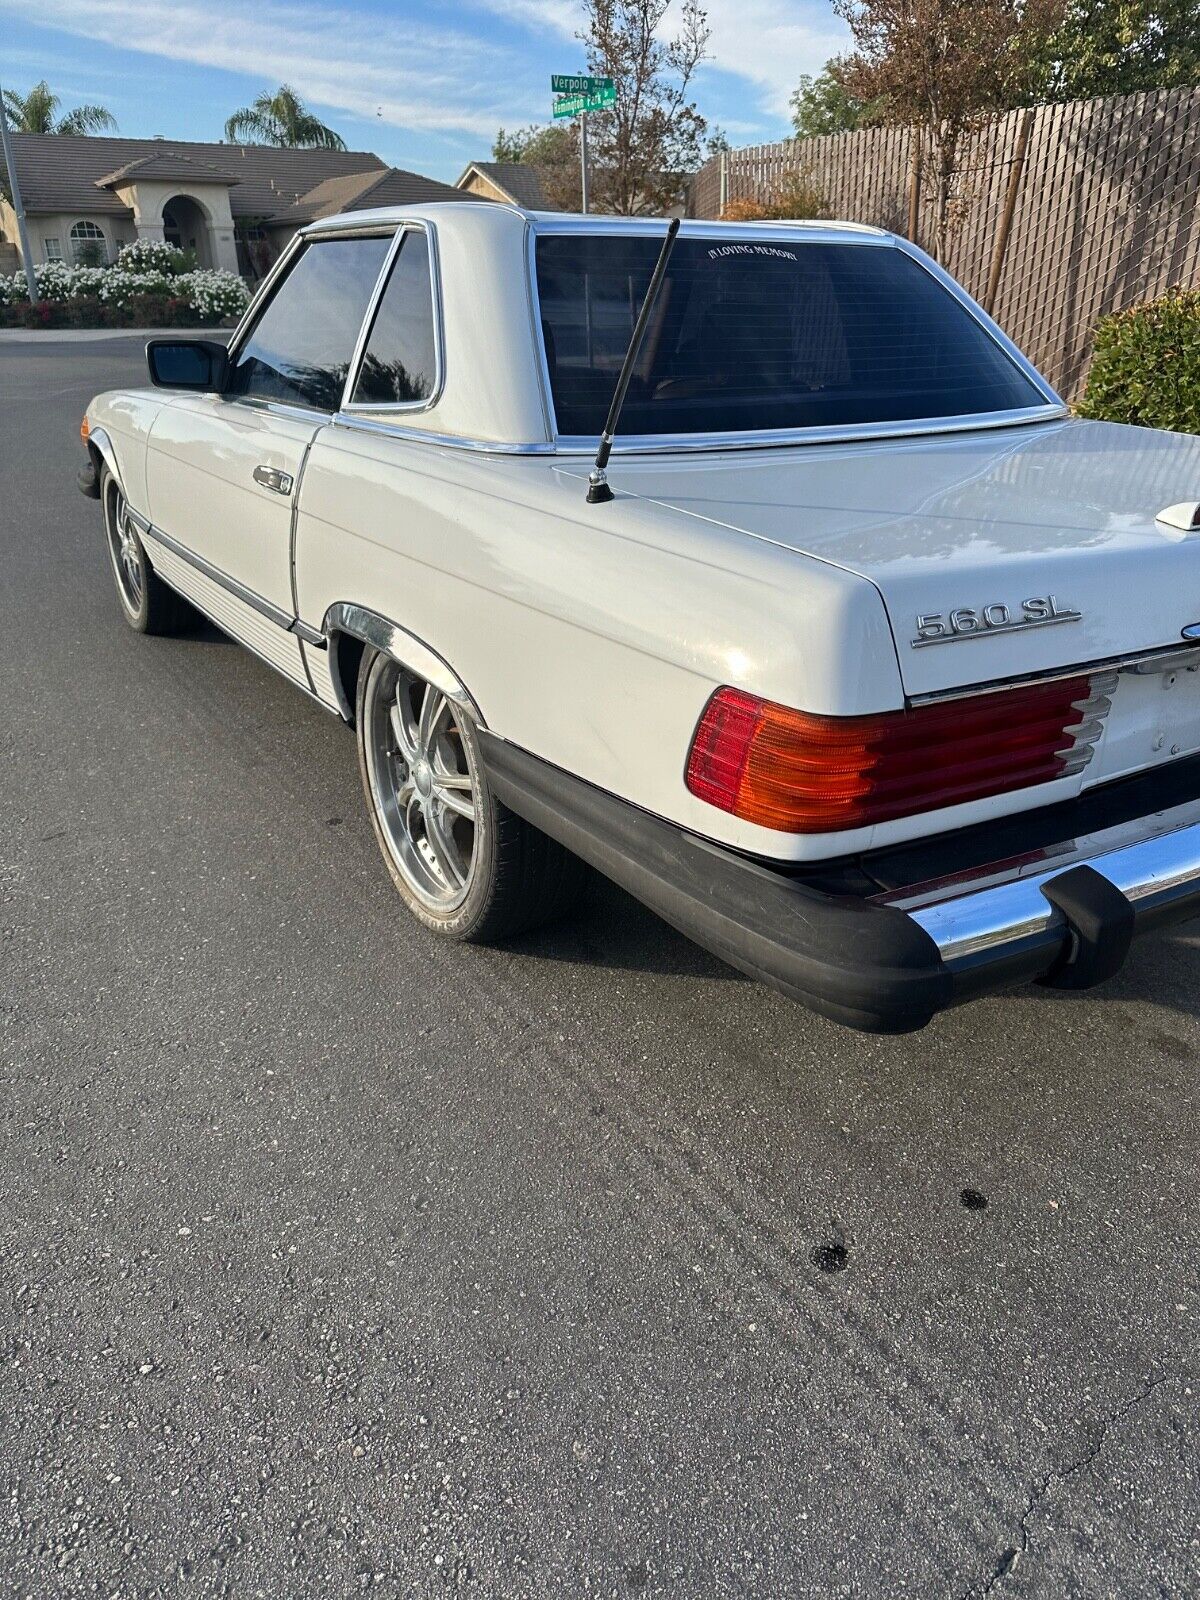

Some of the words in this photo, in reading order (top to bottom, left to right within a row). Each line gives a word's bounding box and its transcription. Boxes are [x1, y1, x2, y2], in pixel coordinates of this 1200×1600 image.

[553, 75, 588, 92] Verpolo
[587, 92, 602, 107] Park
[708, 249, 719, 260] IN
[717, 245, 754, 257] LOVING
[753, 246, 798, 261] MEMORY
[916, 602, 1011, 639] 560
[1021, 593, 1072, 623] SL
